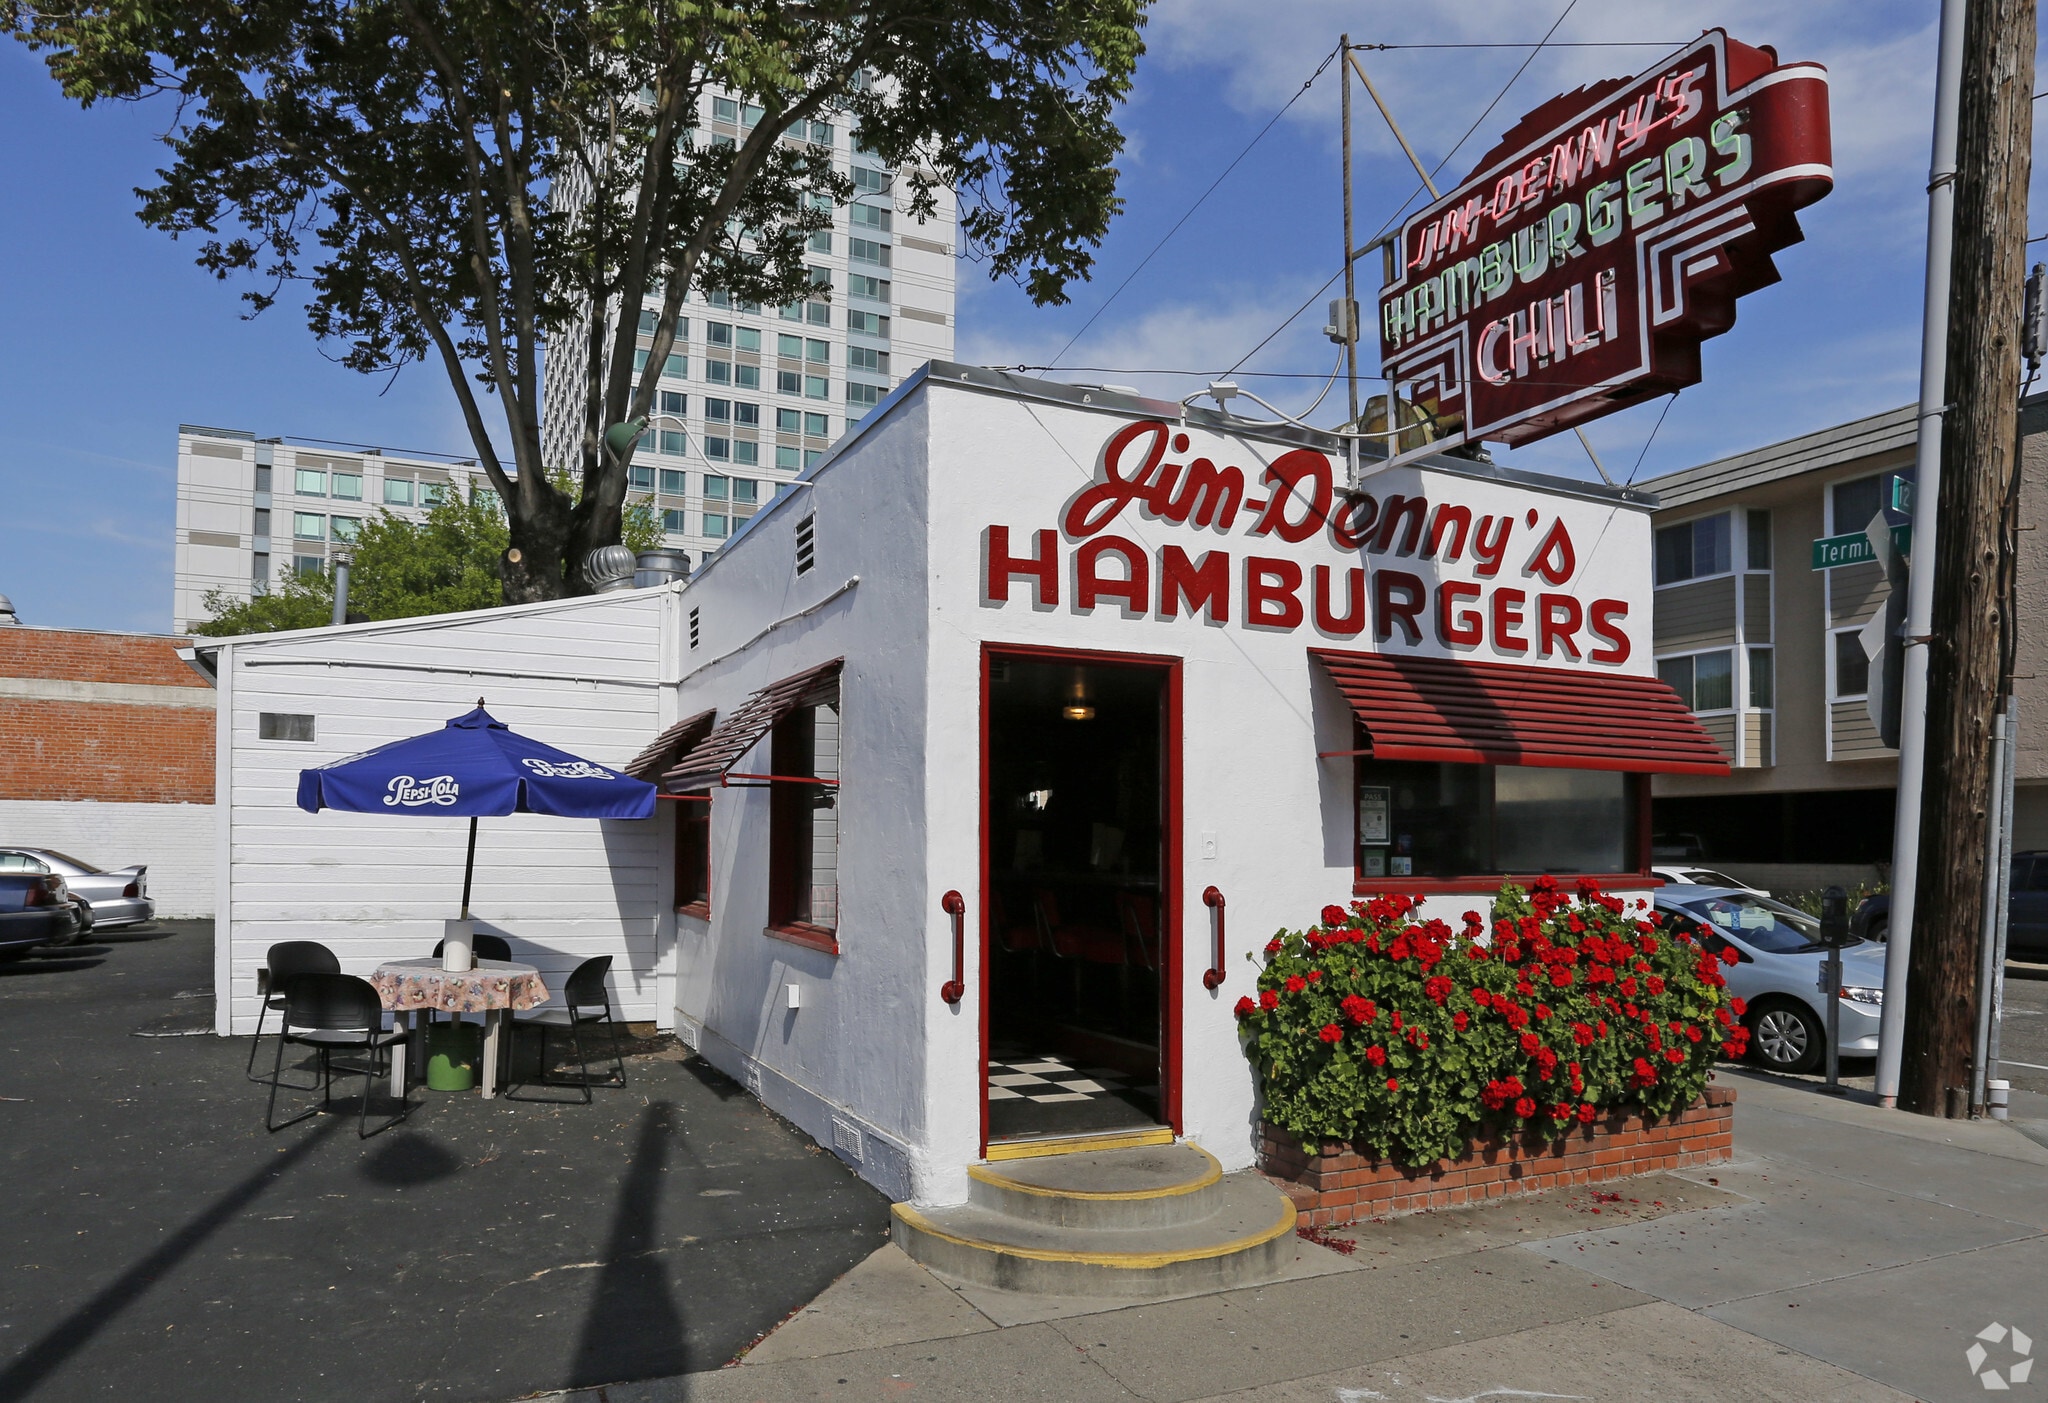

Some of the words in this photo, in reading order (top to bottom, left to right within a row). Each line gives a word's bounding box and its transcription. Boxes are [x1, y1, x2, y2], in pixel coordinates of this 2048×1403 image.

[1384, 107, 1753, 348] HAMBURGERS
[1408, 63, 1707, 270] JIM-DENNY'S
[1476, 268, 1619, 386] CHILI
[1059, 420, 1577, 586] Jim-Denny's
[980, 524, 1631, 666] HAMBURGERS
